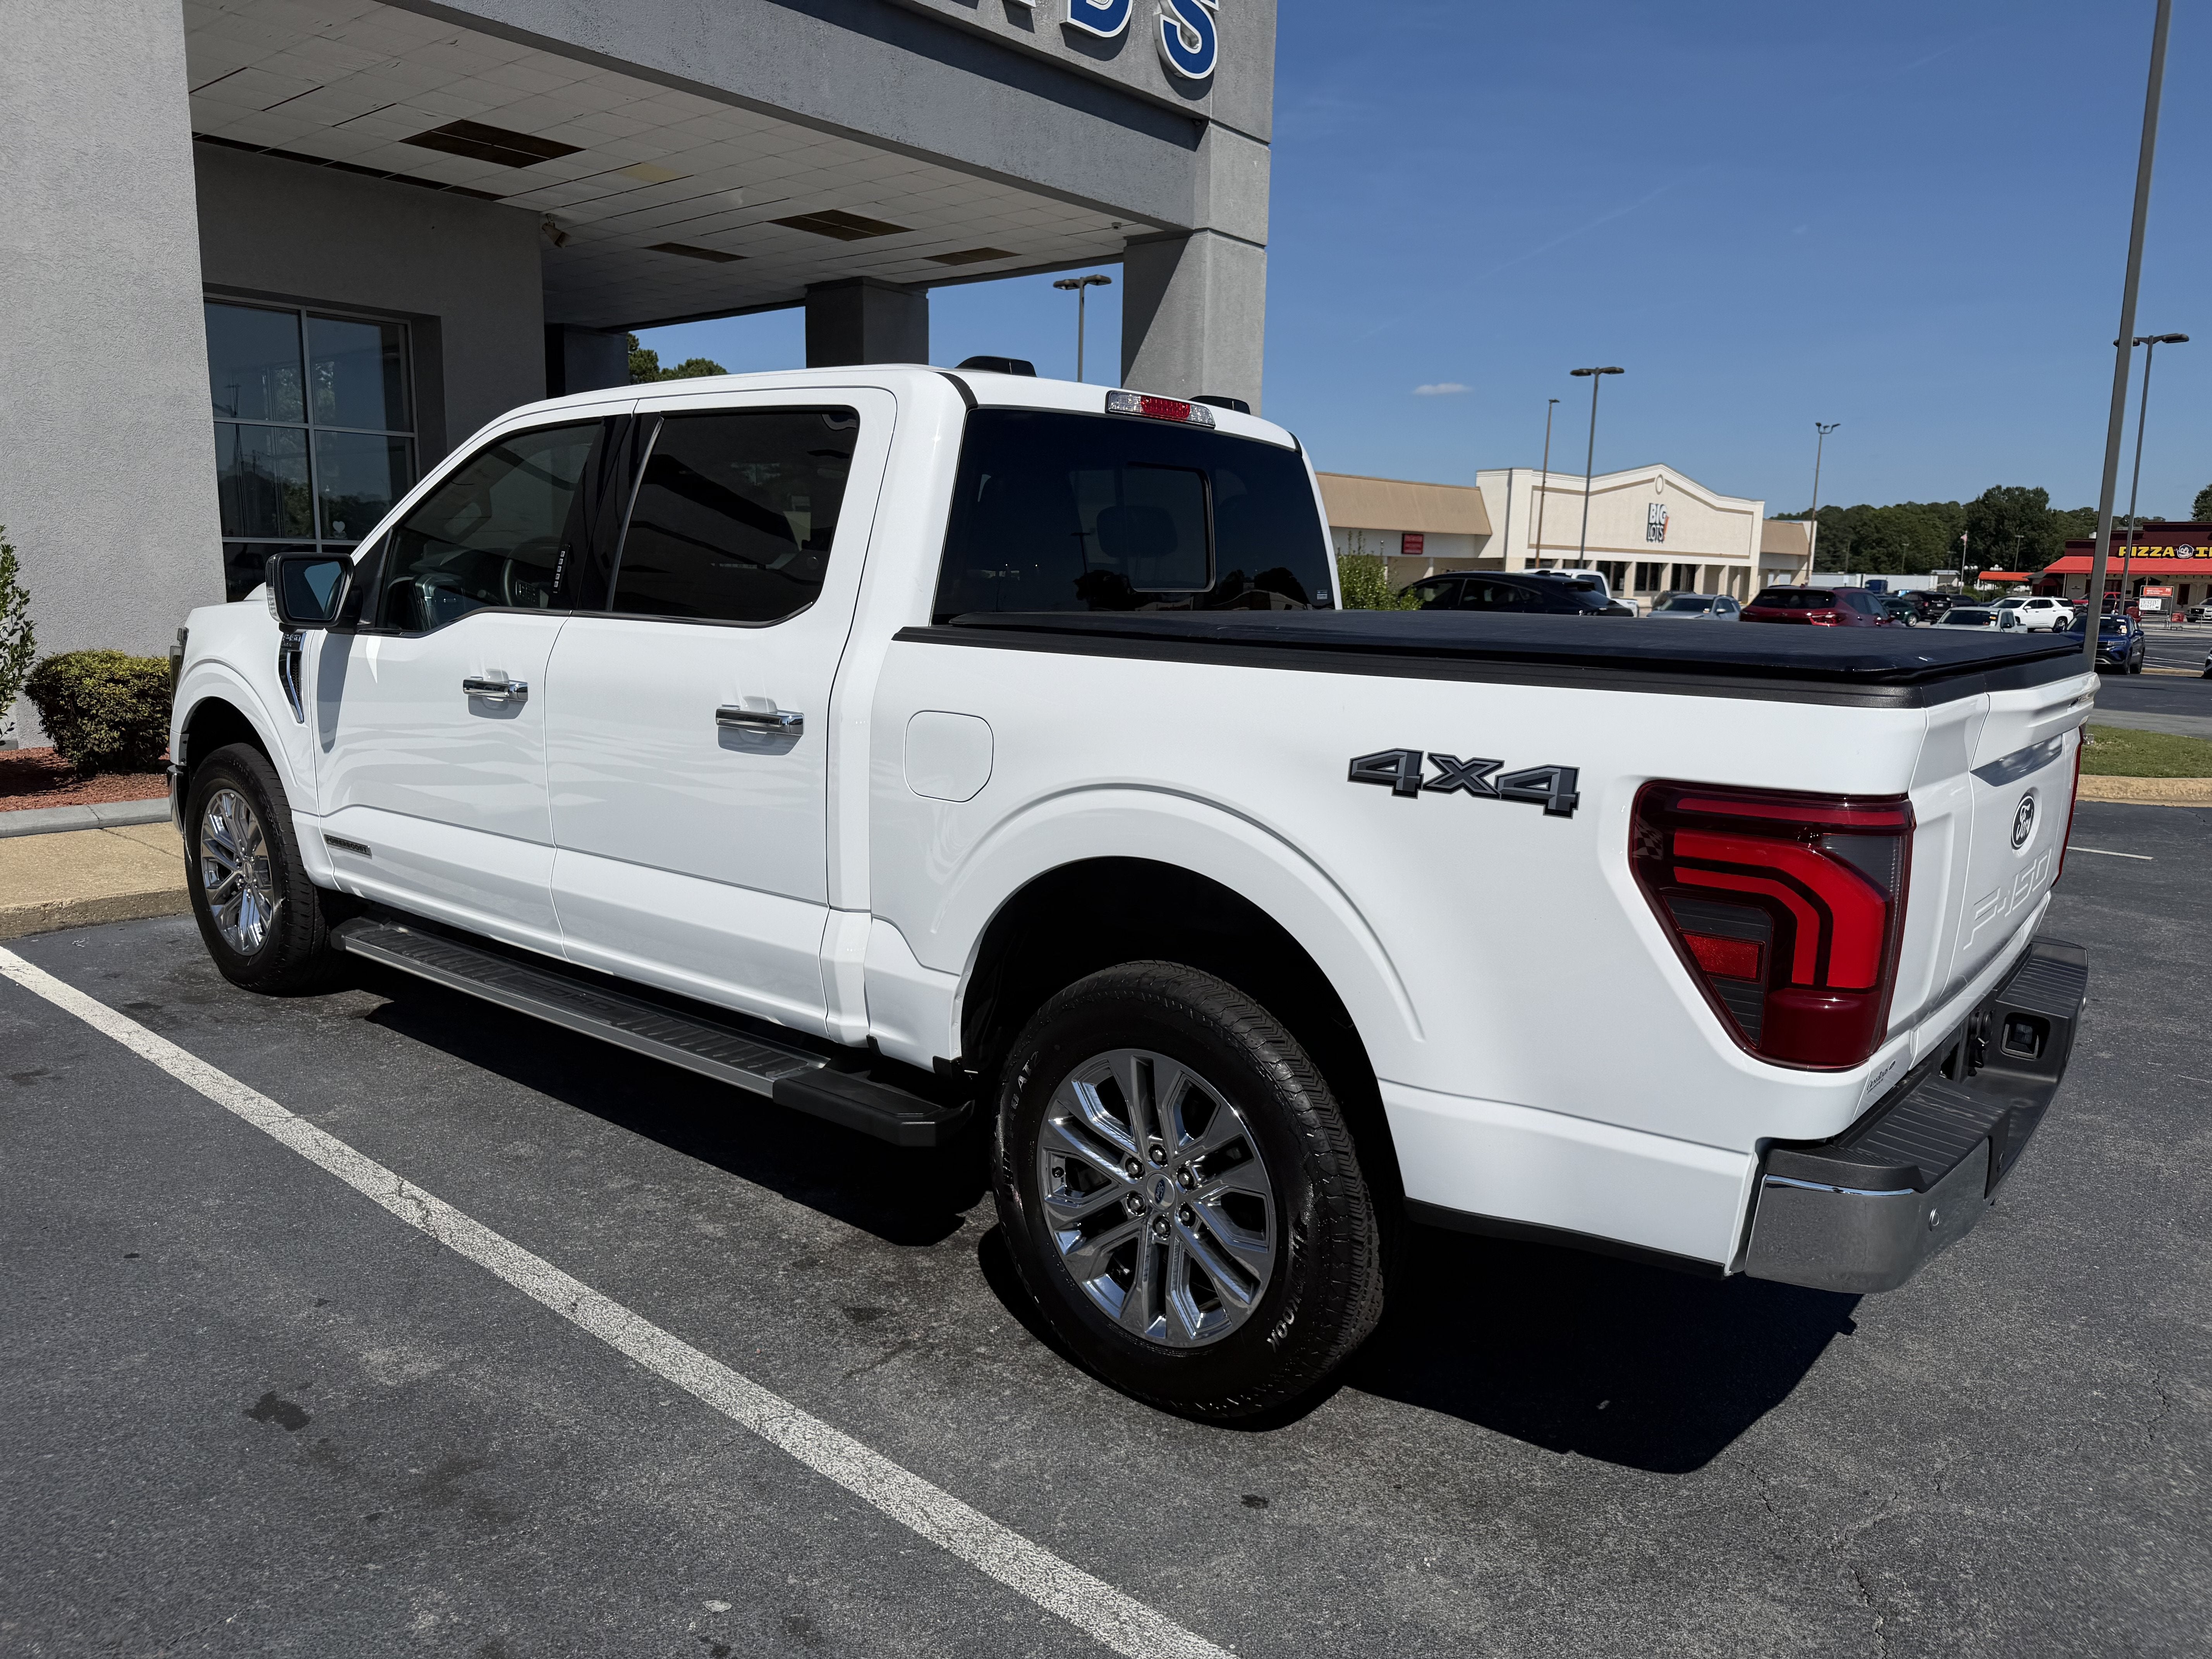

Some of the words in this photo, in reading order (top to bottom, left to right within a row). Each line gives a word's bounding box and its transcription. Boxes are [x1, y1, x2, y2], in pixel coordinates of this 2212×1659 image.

[1649, 503, 1667, 524] BIG
[2119, 546, 2175, 556] PIZZA
[2015, 803, 2034, 841] Ford
[326, 836, 367, 853] POWERBOOST
[1963, 848, 2052, 951] F-150
